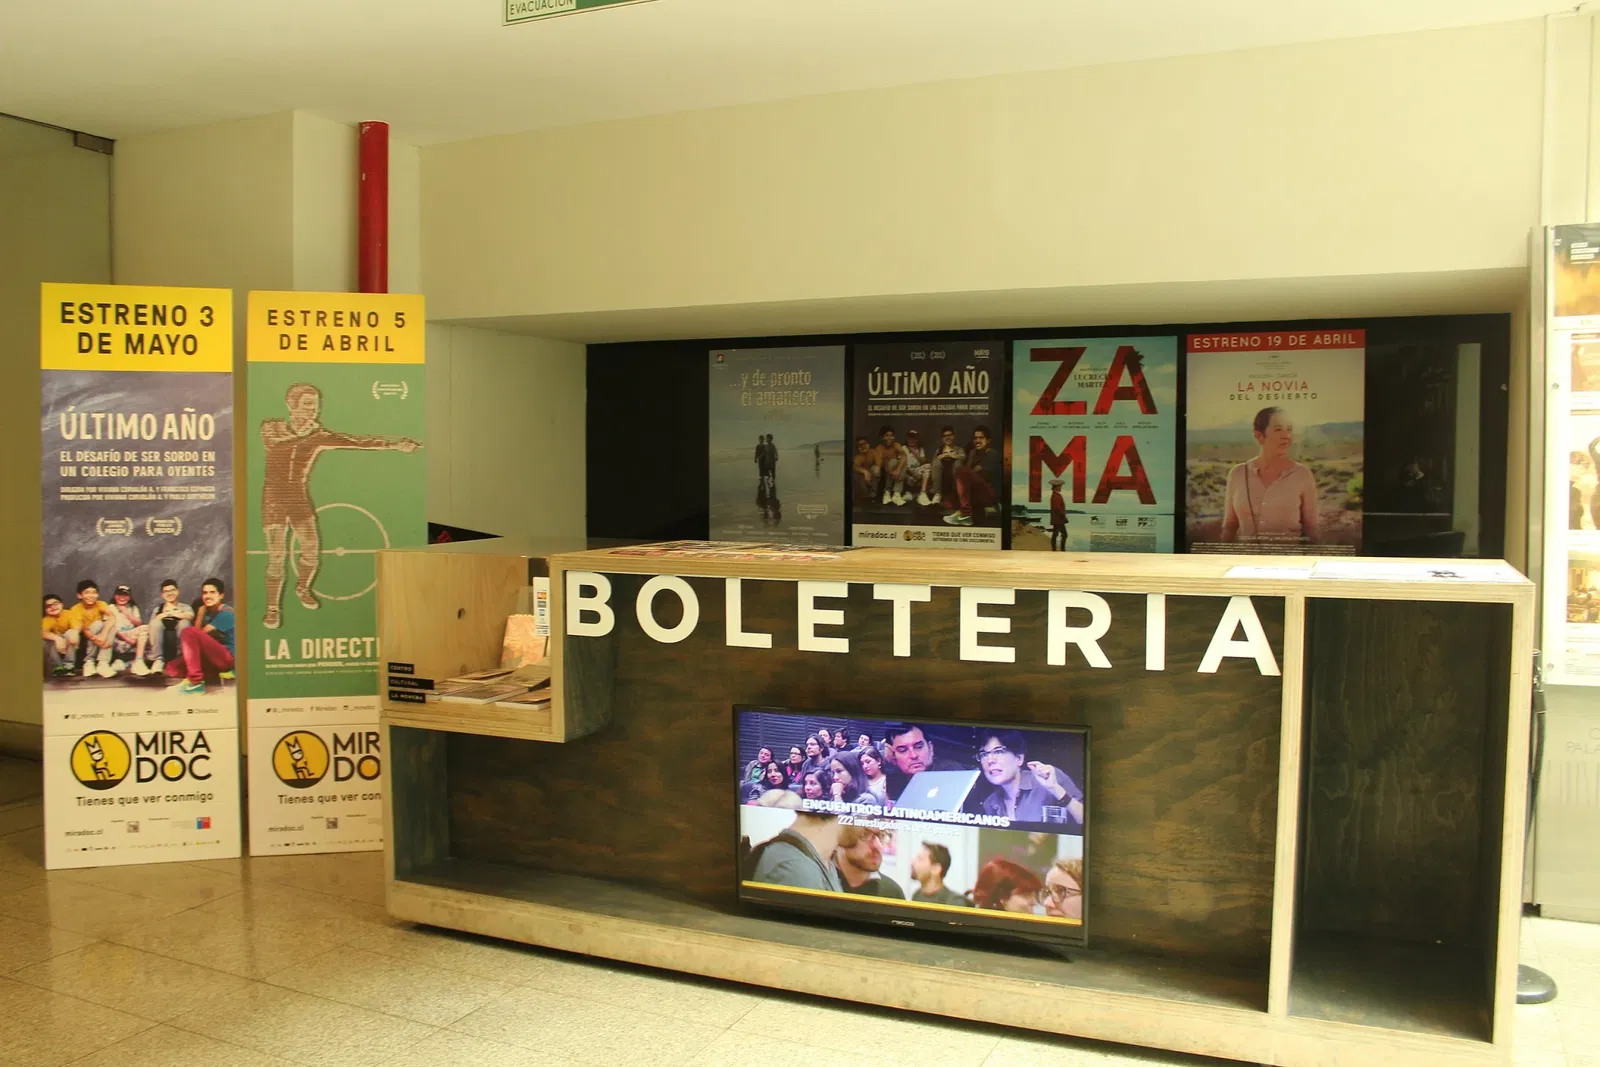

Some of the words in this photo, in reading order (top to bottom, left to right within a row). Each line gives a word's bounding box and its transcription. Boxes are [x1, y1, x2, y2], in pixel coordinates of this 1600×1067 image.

[60, 302, 187, 327] ESTRENO
[199, 305, 214, 327] 3
[267, 309, 379, 328] ESTRENO
[394, 312, 406, 328] 5
[77, 332, 112, 354] DE
[125, 333, 199, 356] MAYO
[279, 334, 308, 351] DE
[322, 335, 395, 352] ABRIL
[1193, 336, 1261, 349] ESTRENO
[1268, 336, 1282, 346] 19
[1288, 335, 1307, 346] DE
[1313, 334, 1357, 346] ABRIL
[752, 369, 766, 386] de
[770, 369, 812, 388] pronto
[948, 365, 990, 395] AÑO
[1029, 345, 1158, 415] ZA
[1237, 382, 1255, 392] LA
[1261, 380, 1309, 392] NOVIA
[756, 390, 820, 407] amanecer
[1229, 393, 1250, 401] DEL
[1257, 392, 1318, 401] DESIERTO
[162, 407, 215, 440] AÑO
[60, 451, 72, 462] EL
[76, 449, 121, 462] DESAFÍO
[124, 451, 138, 462] DE
[141, 451, 161, 462] SER
[164, 451, 199, 462] SORDO
[202, 451, 215, 462] EN
[60, 466, 77, 477] UN
[133, 466, 163, 477] PARA
[168, 466, 215, 477] OYENTES
[1028, 435, 1157, 504] MA
[858, 531, 897, 539] miradoc.cl
[565, 571, 1281, 678] BOLETERIA
[264, 639, 291, 660] LA
[135, 731, 211, 756] MIRA
[332, 731, 381, 755] MIR
[136, 755, 212, 783] DOC
[334, 755, 381, 782] DO
[76, 796, 114, 806] Tienes
[118, 795, 139, 807] que
[143, 794, 162, 804] ver
[165, 791, 214, 804] conmigo
[277, 794, 314, 805] Tienes
[317, 794, 338, 805] que
[341, 793, 359, 802] ver
[361, 792, 381, 801] con
[802, 798, 883, 815] ENCUENTROS
[883, 806, 1010, 827] LATINOAMERICANOS
[838, 815, 854, 825] 222
